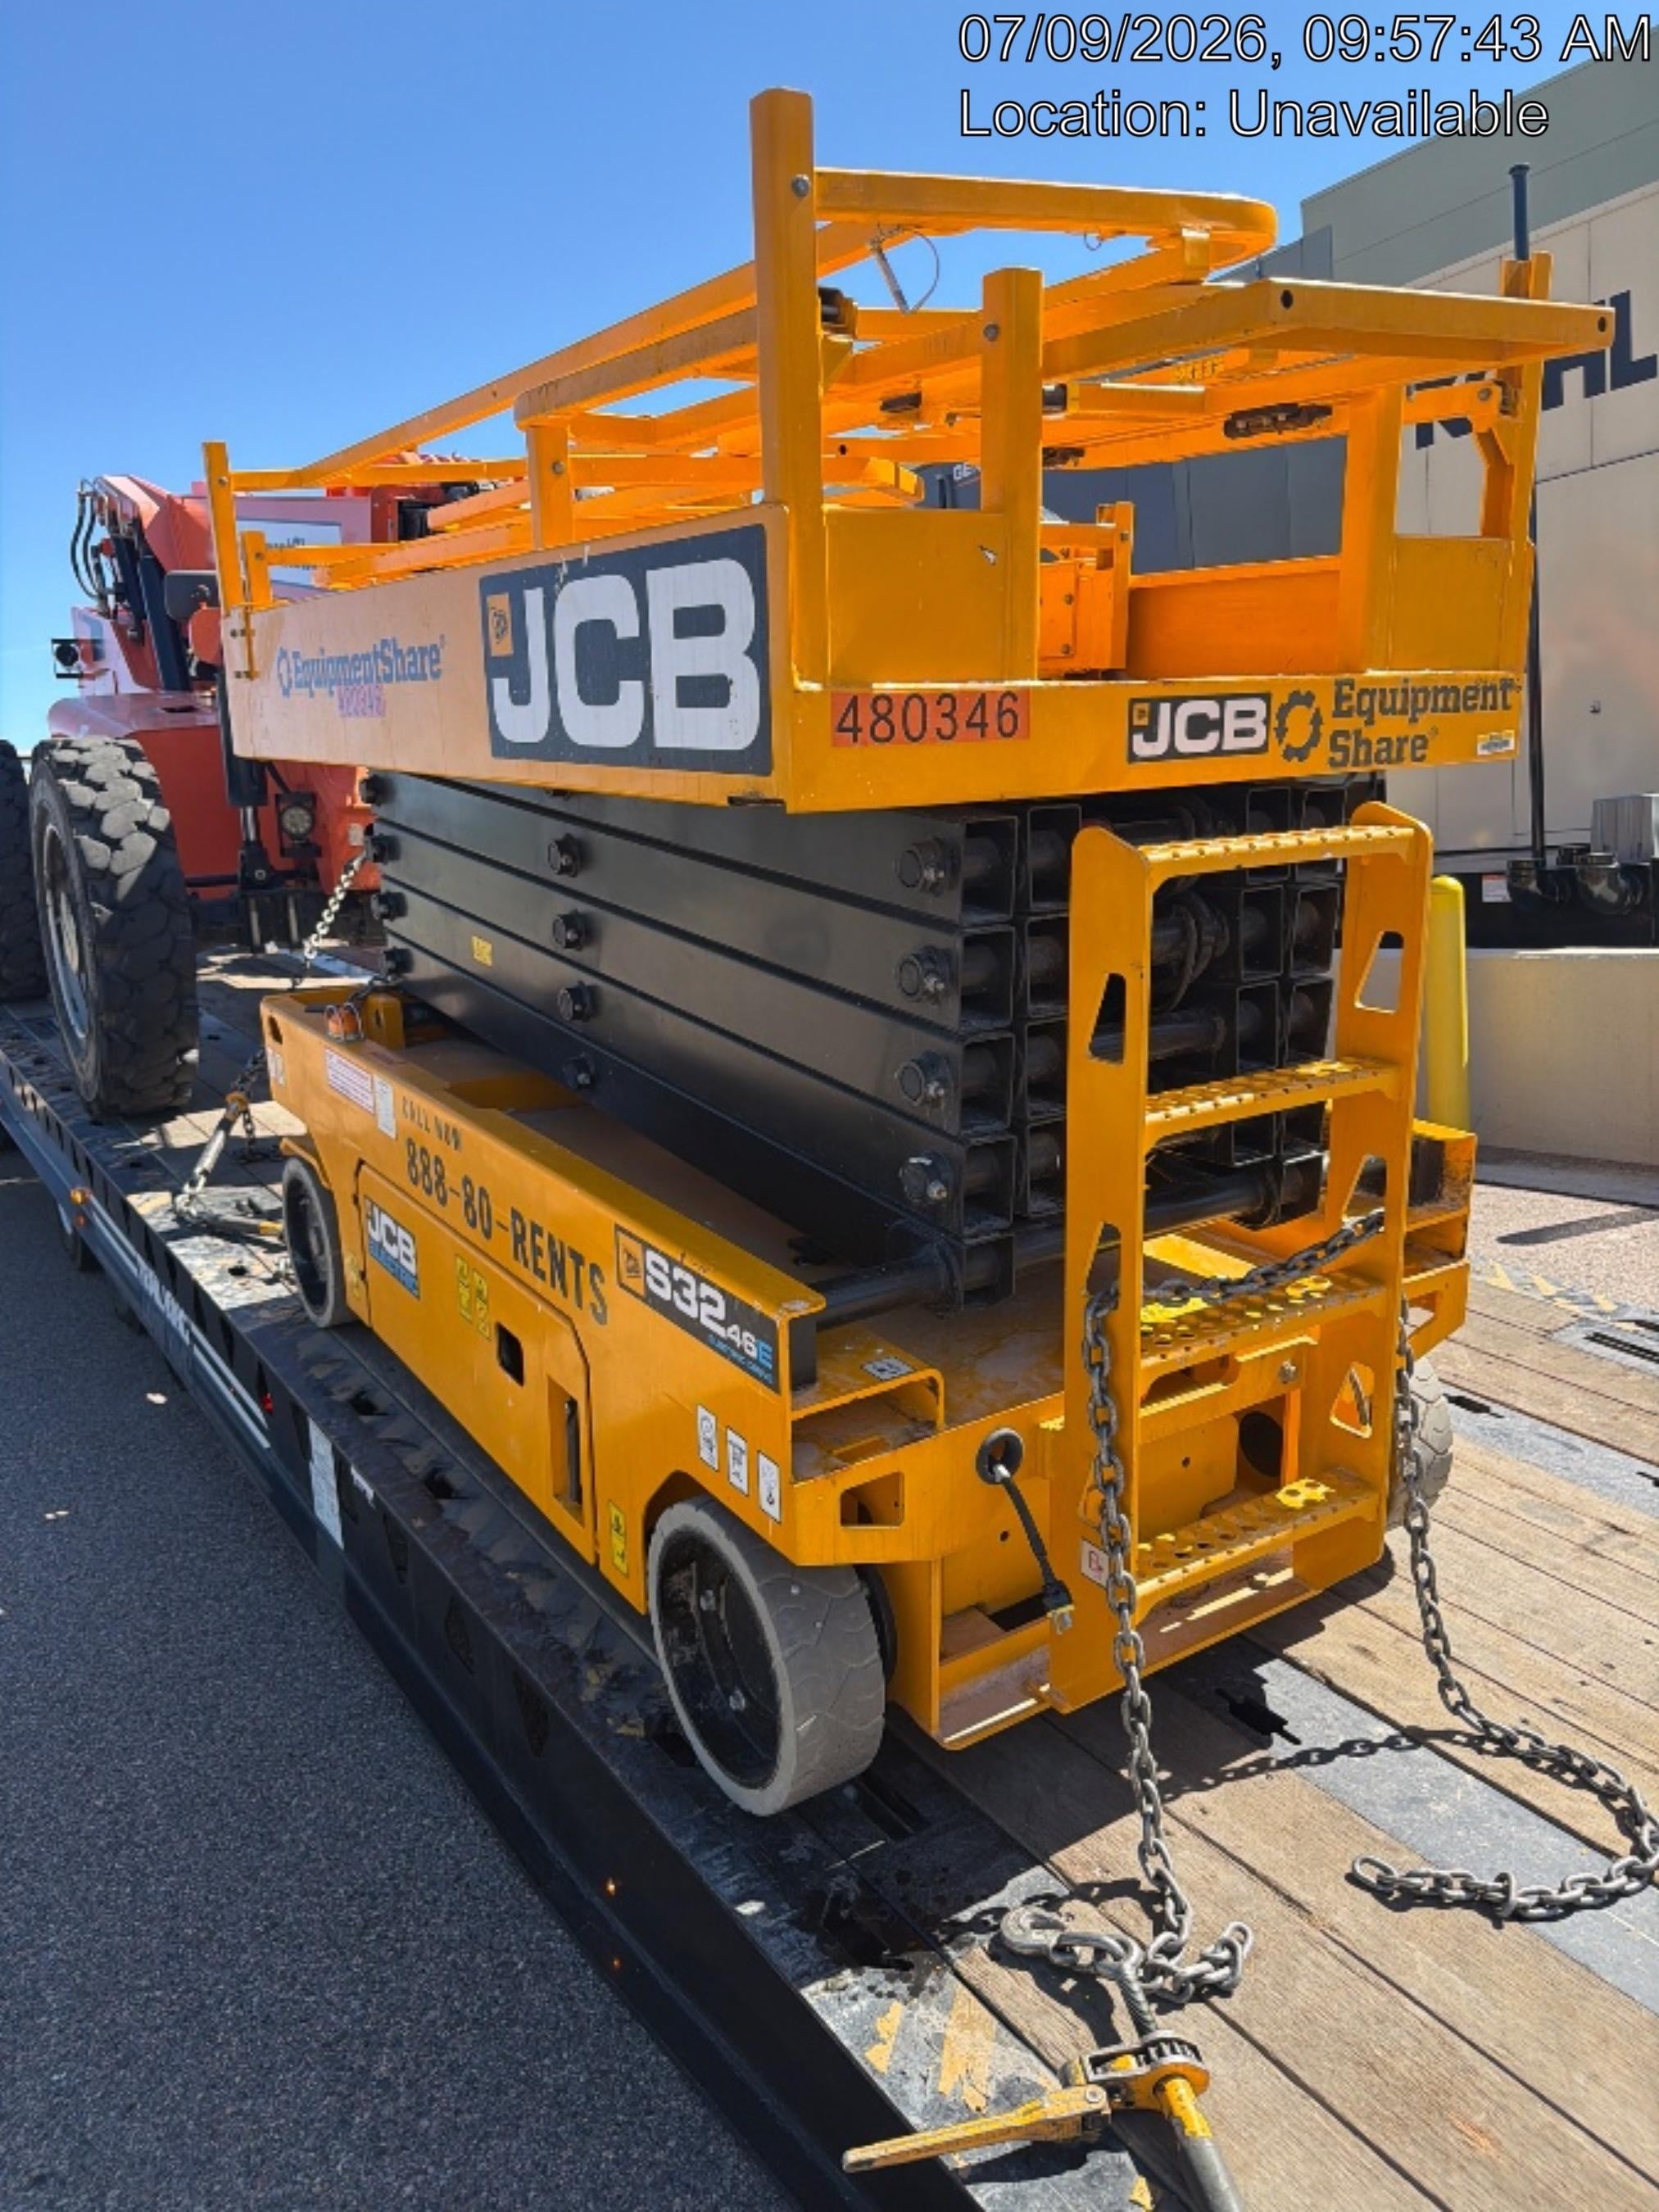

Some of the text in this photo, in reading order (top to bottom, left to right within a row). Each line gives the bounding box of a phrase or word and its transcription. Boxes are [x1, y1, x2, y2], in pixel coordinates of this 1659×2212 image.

[492, 557, 761, 751] JCB
[836, 691, 1019, 743] 480346
[1131, 698, 1267, 758] JCB
[369, 1203, 417, 1276] JCB
[406, 1136, 608, 1326] 888-80-RENTS
